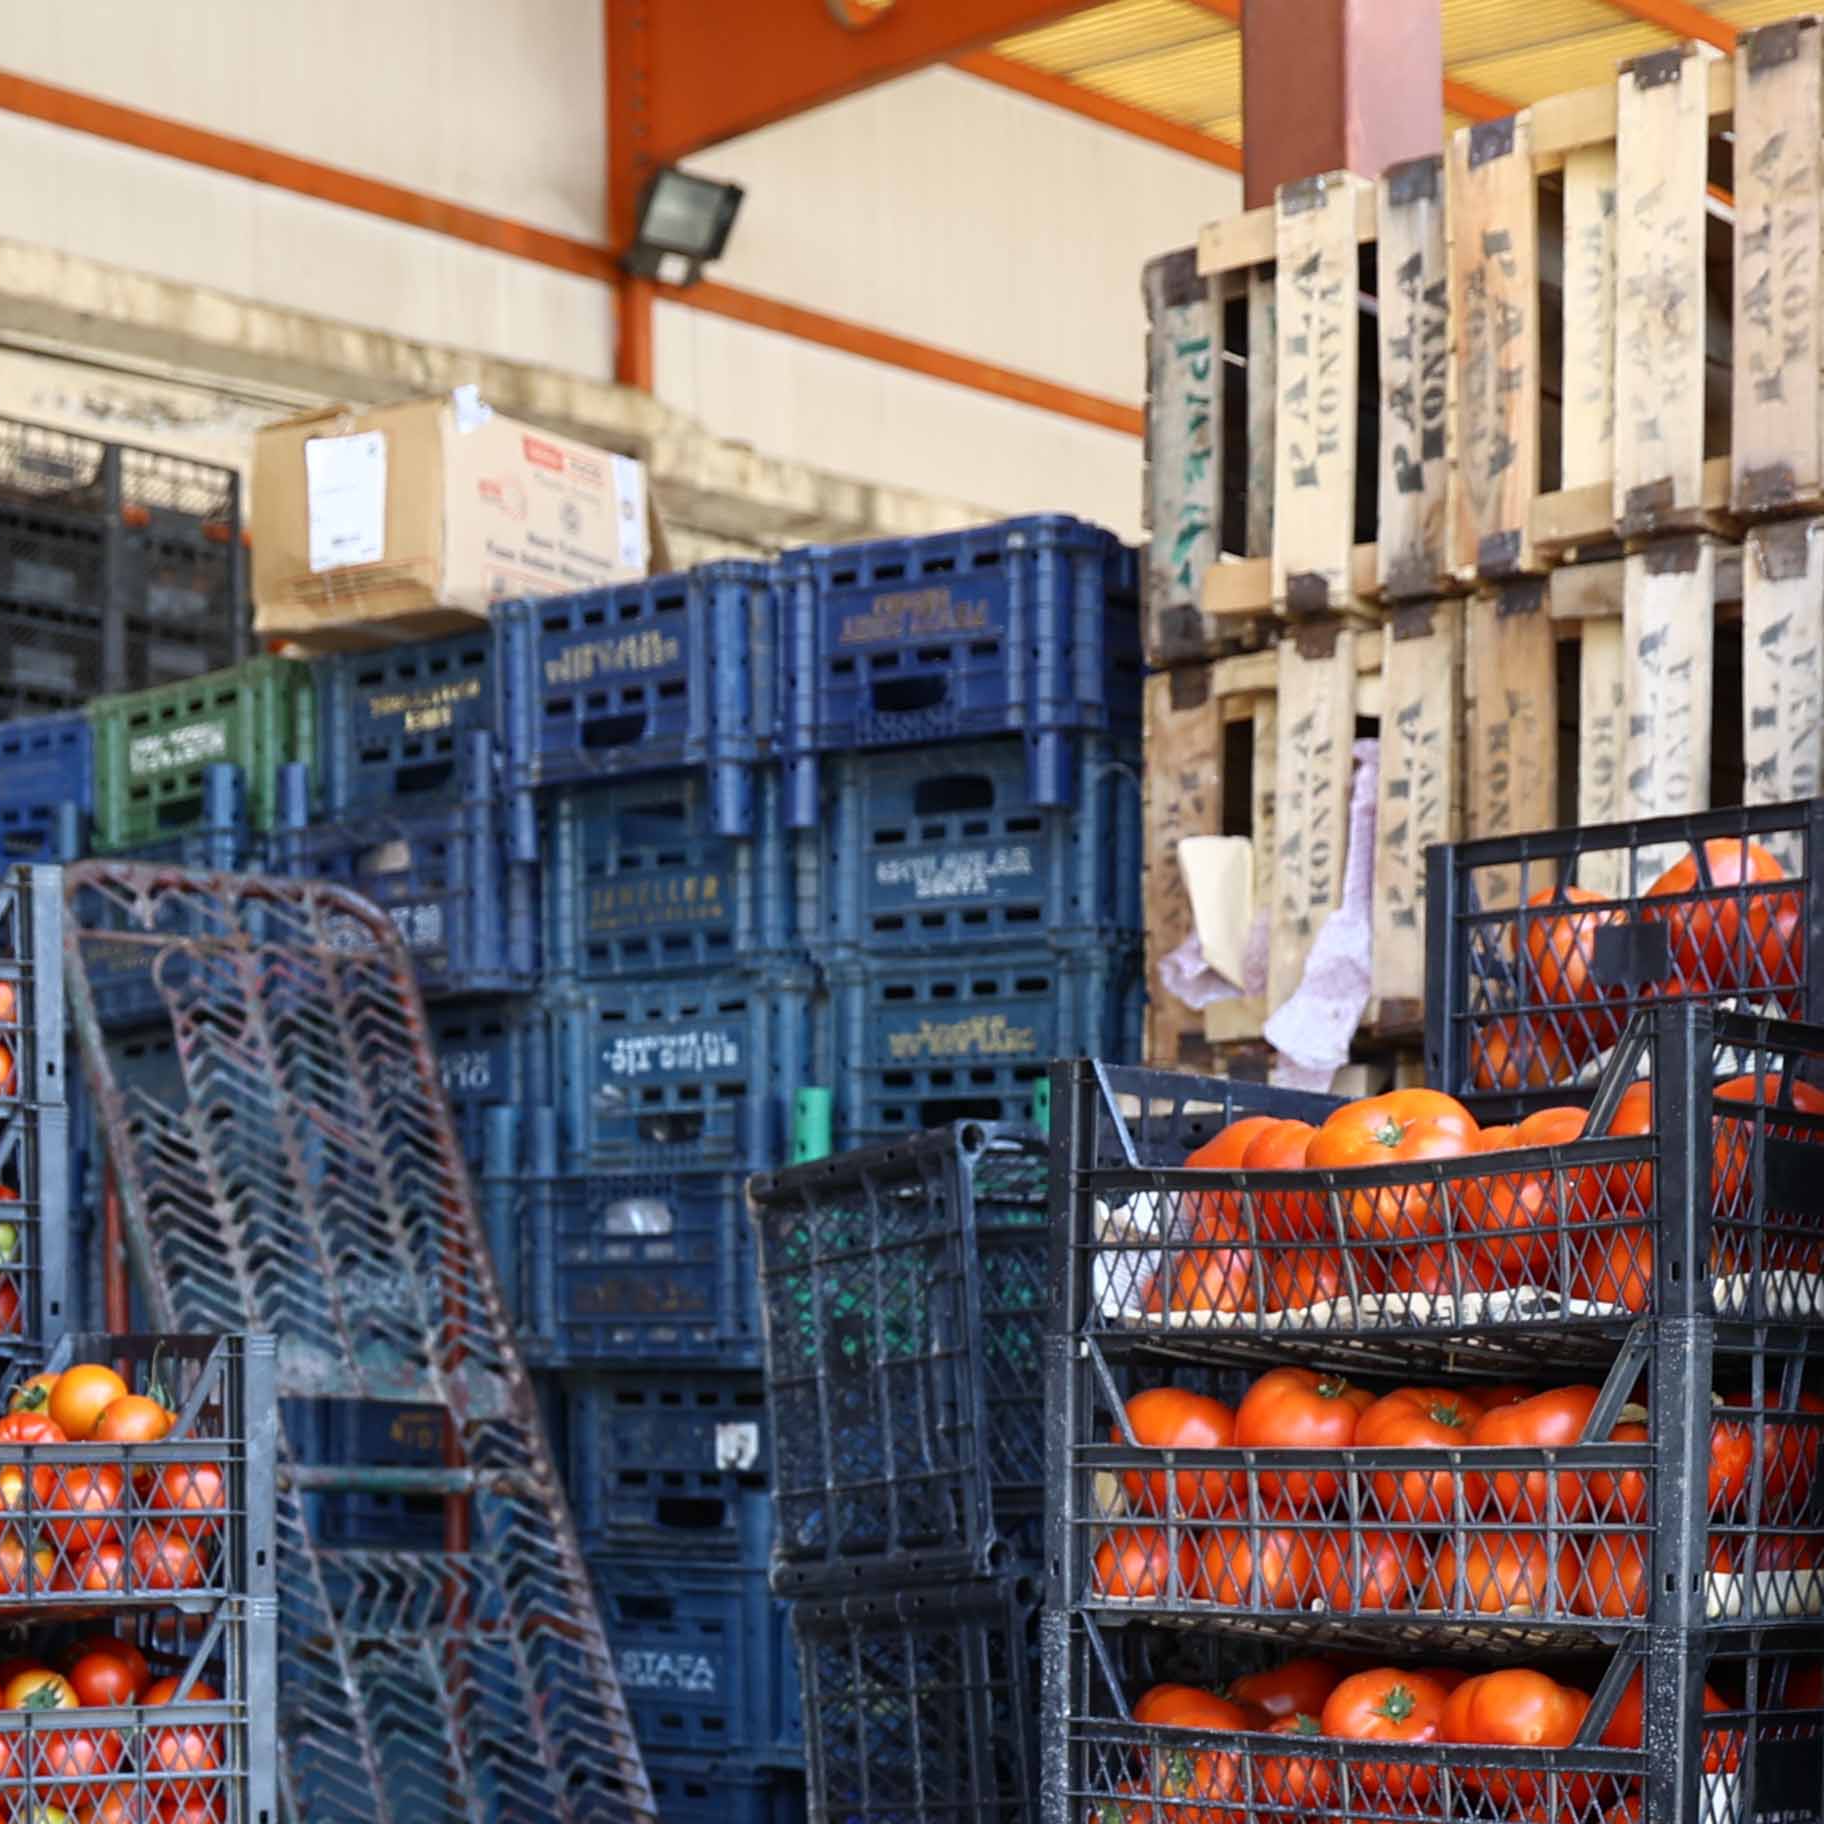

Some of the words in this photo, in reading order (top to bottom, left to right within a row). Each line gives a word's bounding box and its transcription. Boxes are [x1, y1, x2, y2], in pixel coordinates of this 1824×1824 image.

[1283, 251, 1322, 488] PALA
[1315, 274, 1342, 455] KONYA
[1388, 251, 1424, 493] PALA
[1483, 229, 1526, 479] PALA
[1743, 133, 1788, 403] PALA
[1780, 165, 1810, 364] KONYA
[1280, 711, 1316, 936] PALA
[1309, 738, 1333, 908] KONYA
[1384, 700, 1424, 929] PALA
